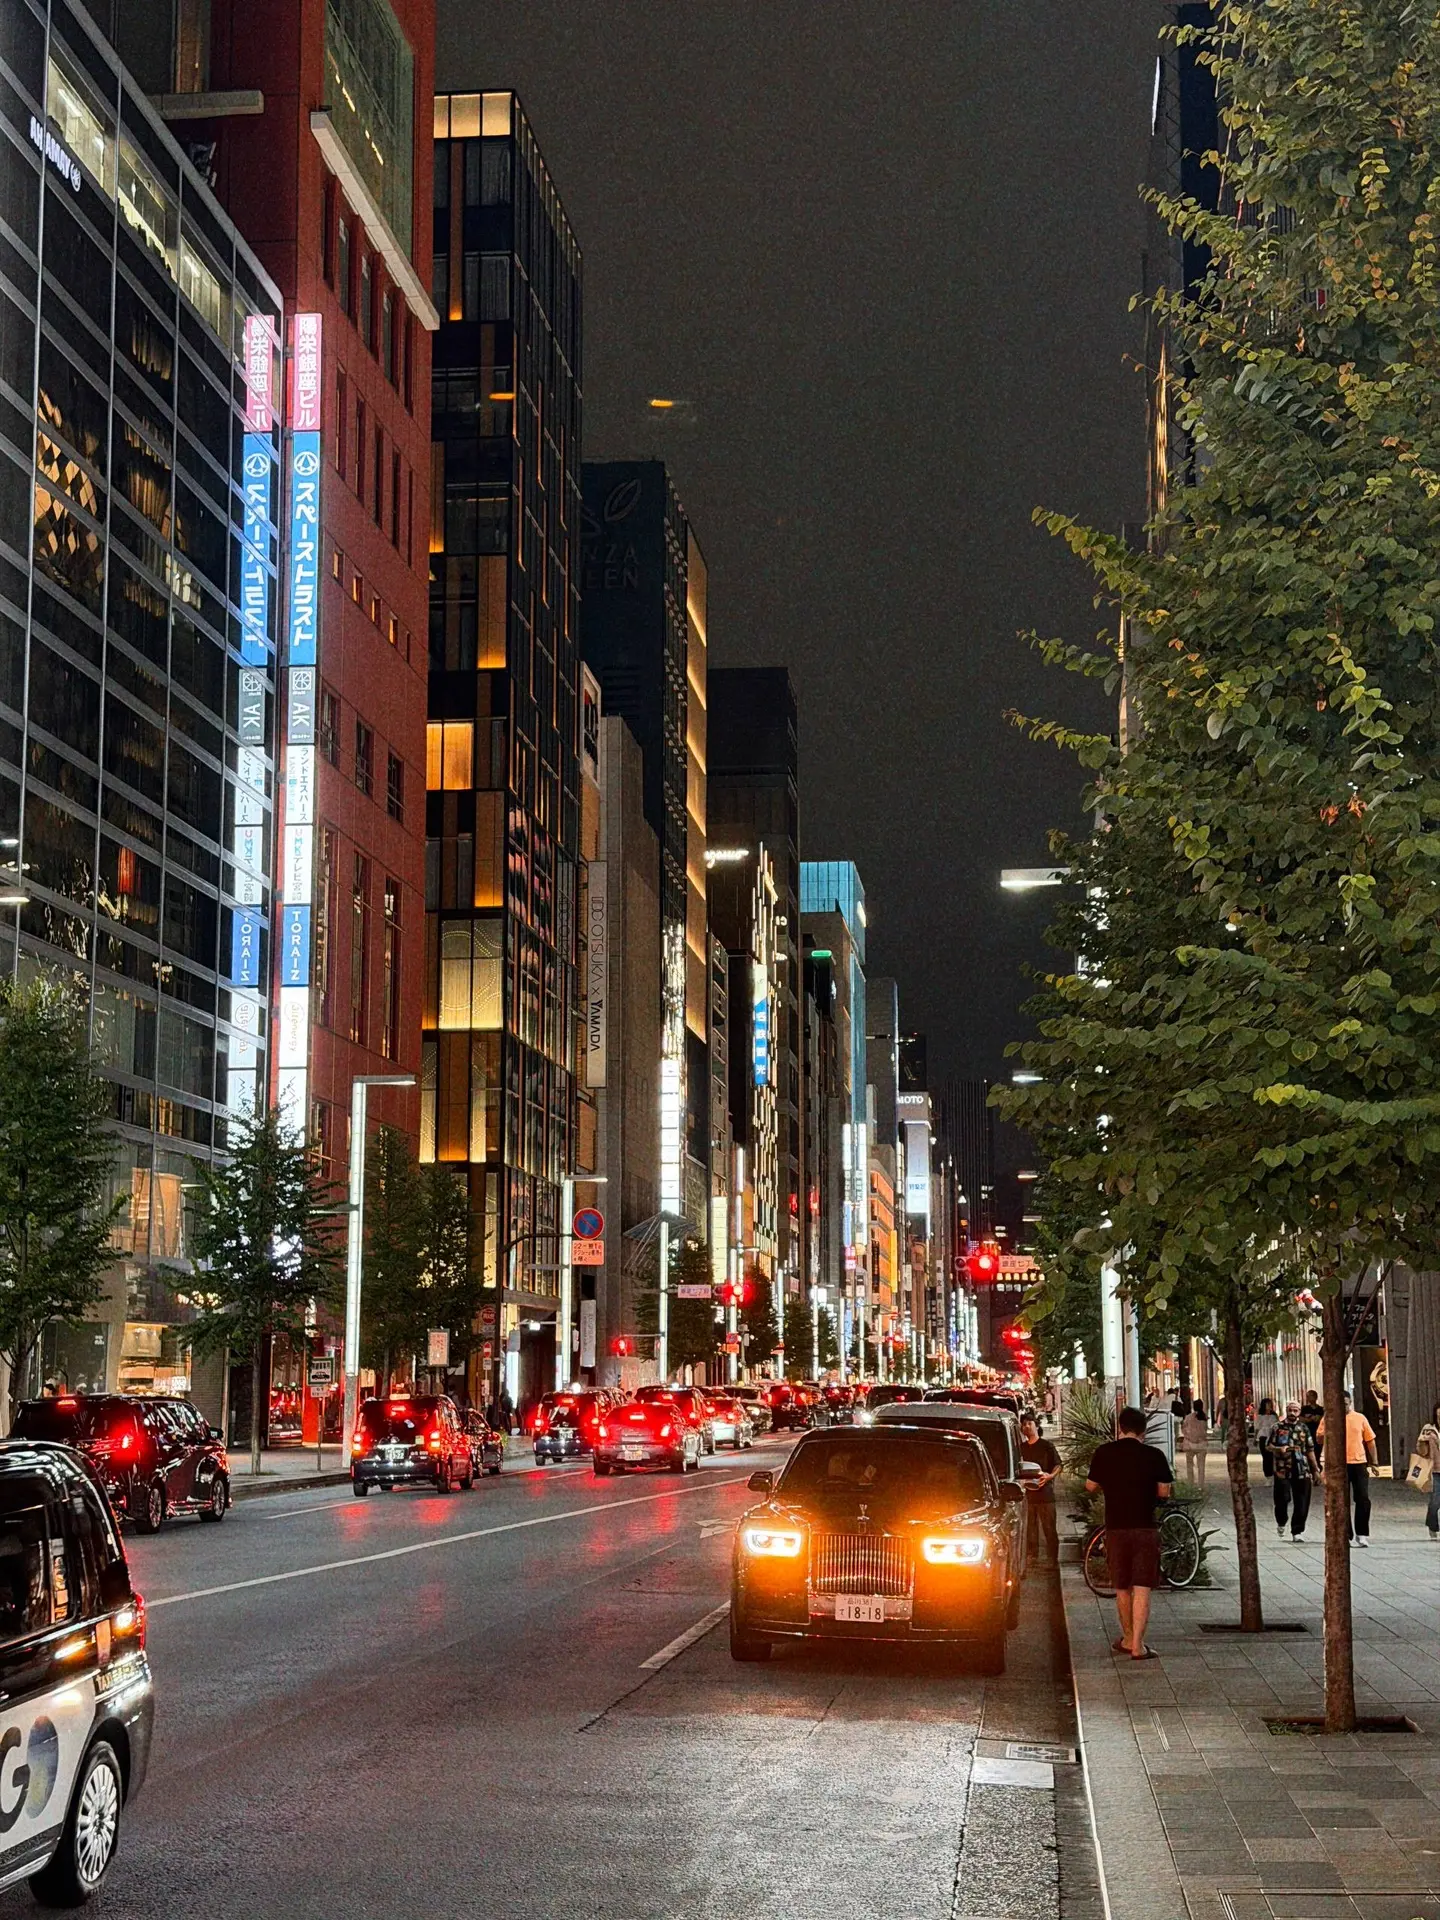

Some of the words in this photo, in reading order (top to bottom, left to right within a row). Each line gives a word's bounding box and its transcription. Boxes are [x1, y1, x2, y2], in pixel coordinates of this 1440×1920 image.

[297, 316, 318, 427] 陽栄銀座ビル
[294, 482, 316, 647] スペーストラスト
[292, 702, 310, 727] AK
[290, 911, 303, 981] TORAIZ
[591, 924, 604, 983] OTSUKA
[590, 999, 603, 1051] YAMADA
[848, 1605, 882, 1620] 18-18
